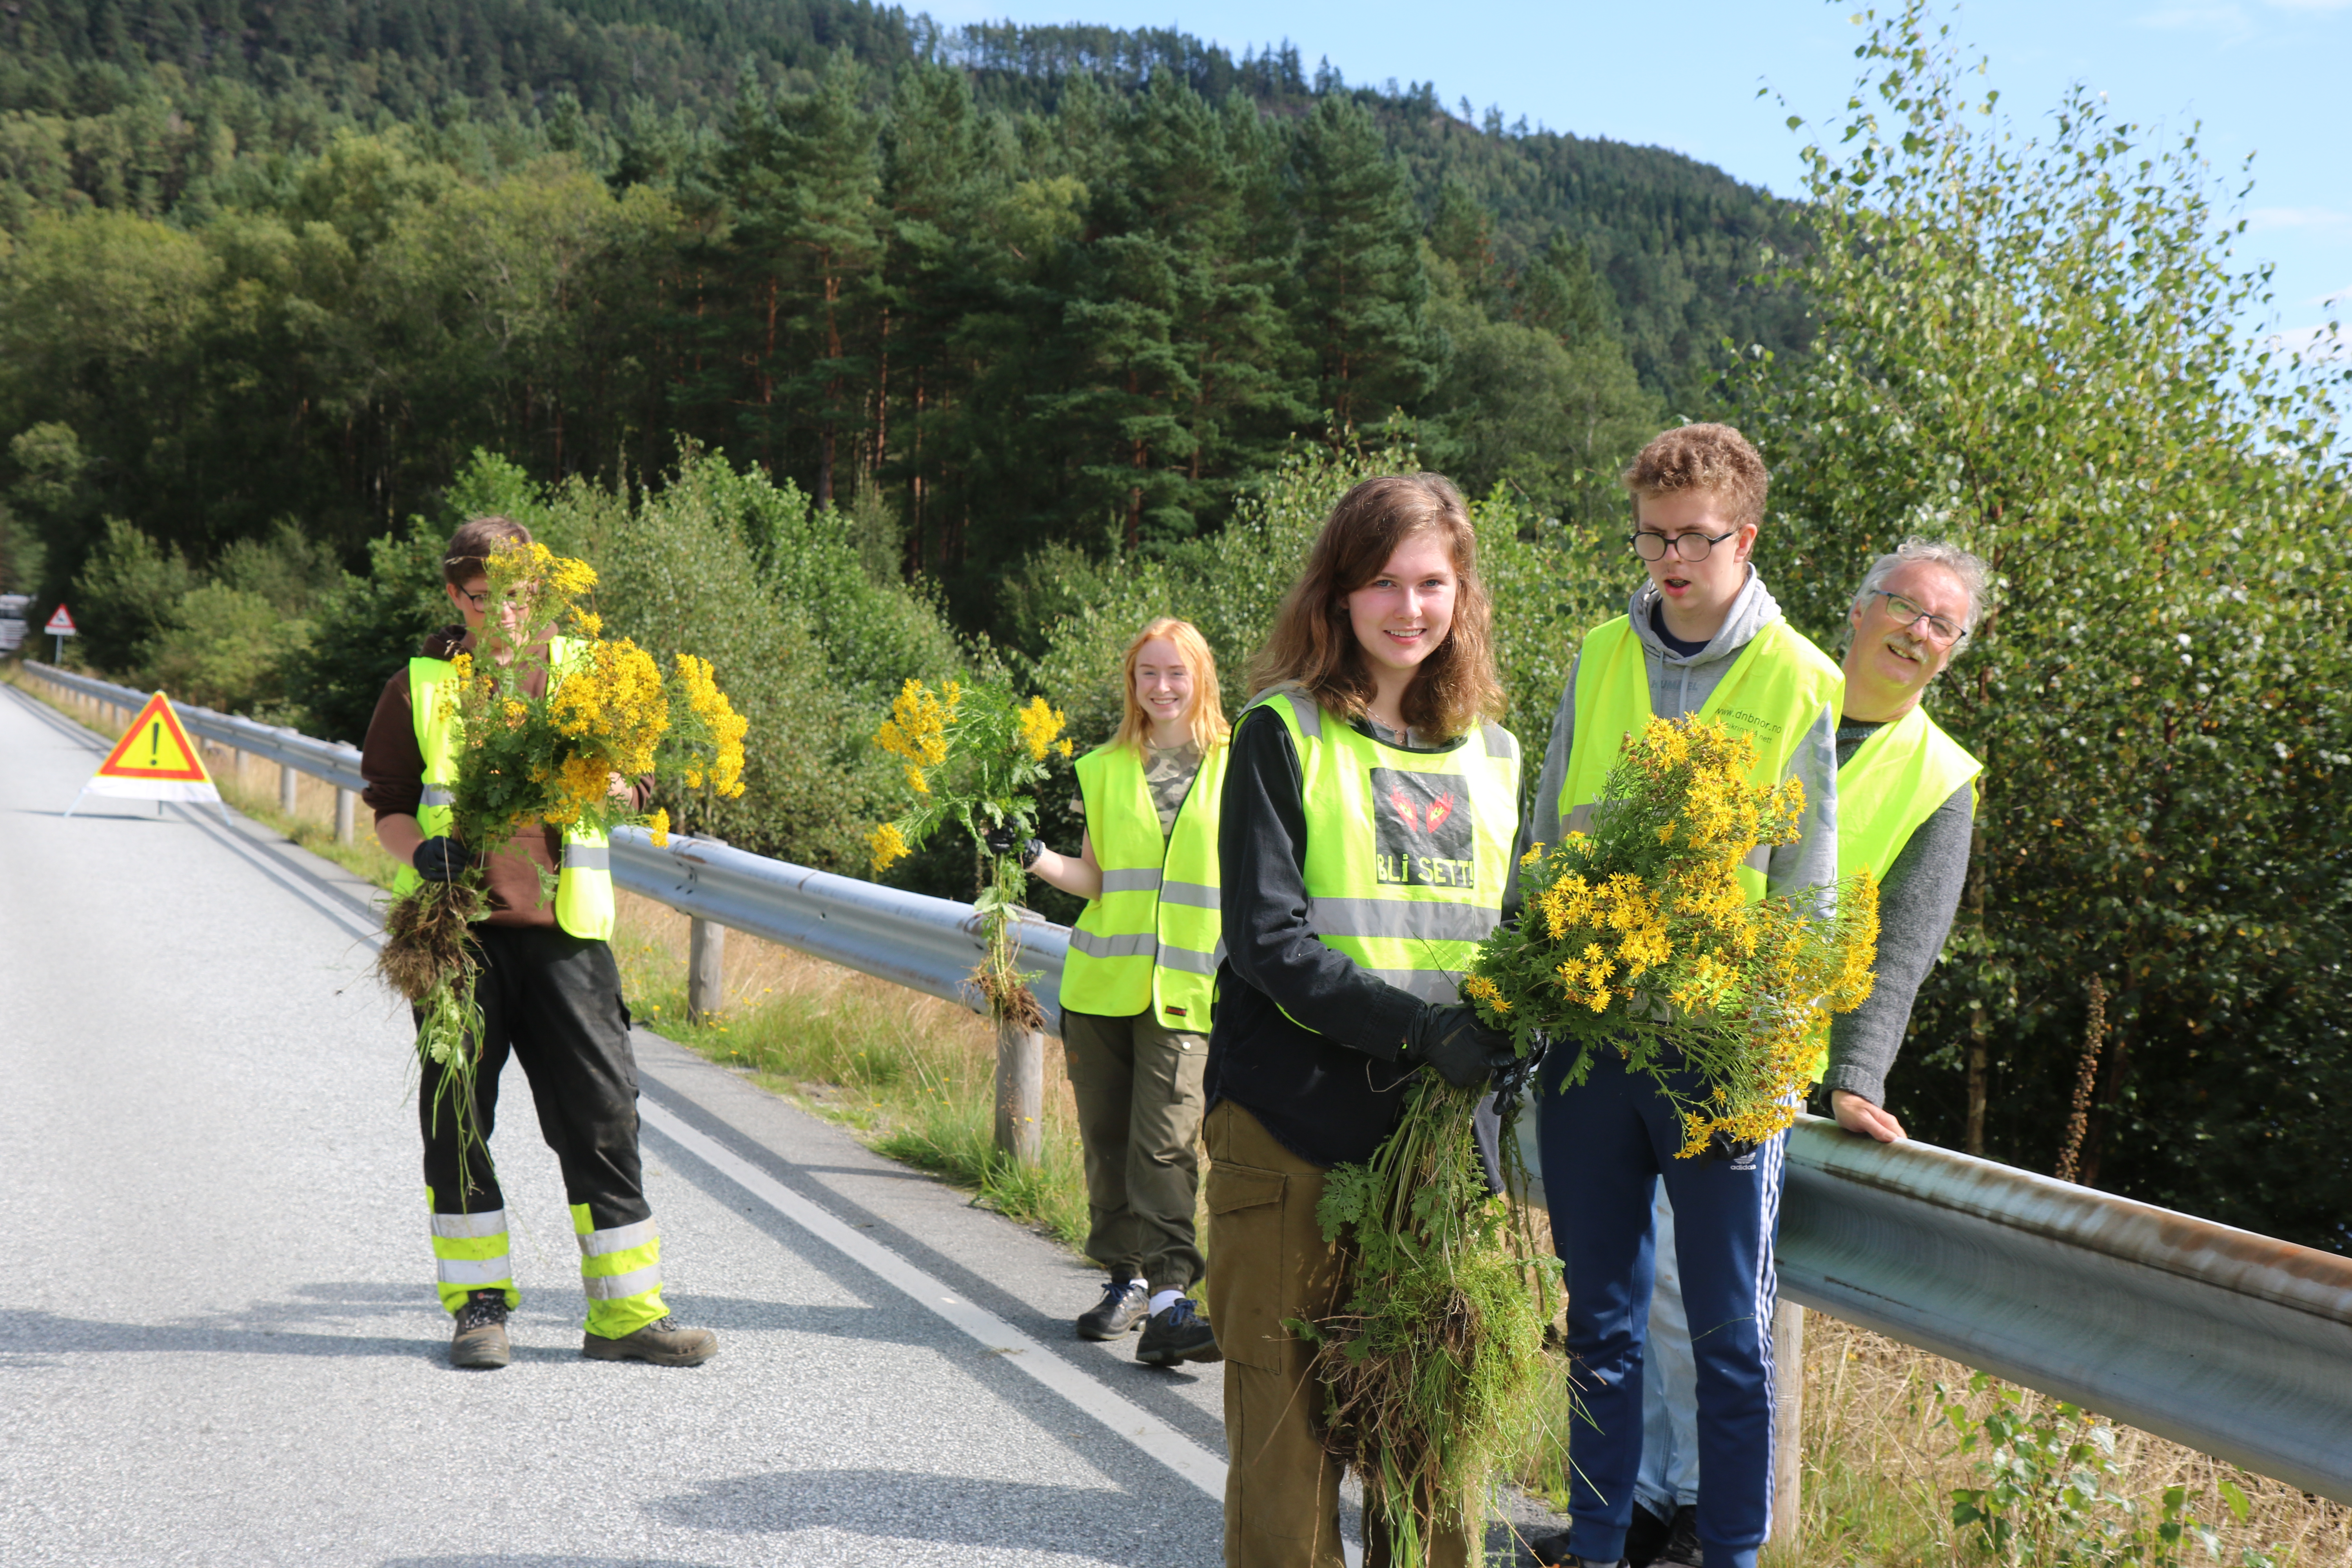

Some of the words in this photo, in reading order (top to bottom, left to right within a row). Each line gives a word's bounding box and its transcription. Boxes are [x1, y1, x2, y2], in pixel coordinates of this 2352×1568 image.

[1715, 708, 1782, 734] www.dnbnor.no
[1759, 735, 1772, 744] nett
[1418, 857, 1474, 886] SETT!
